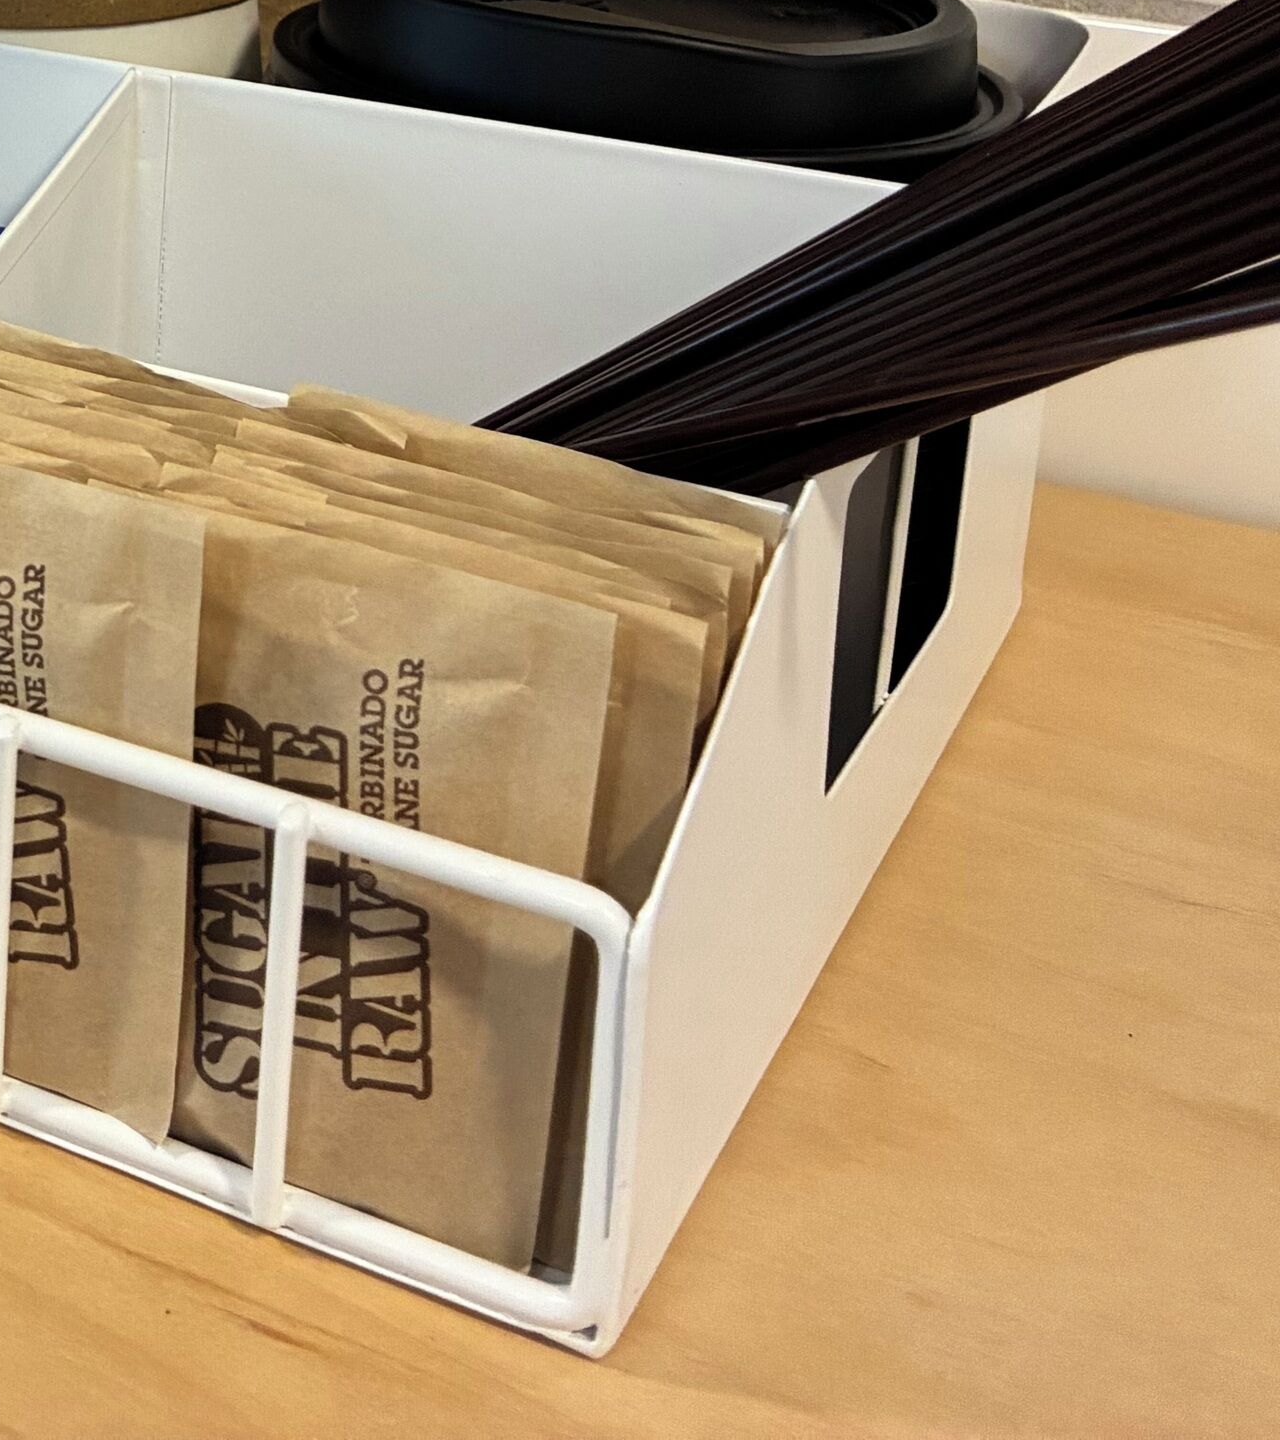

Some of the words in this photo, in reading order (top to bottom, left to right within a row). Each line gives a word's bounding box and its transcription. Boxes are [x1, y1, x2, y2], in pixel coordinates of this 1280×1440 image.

[21, 564, 46, 669] SUGAR
[24, 675, 49, 718] NE
[393, 658, 425, 770] SUGAR
[7, 776, 80, 971] RAW
[292, 948, 344, 1059] IN
[342, 871, 433, 1100] RAW
